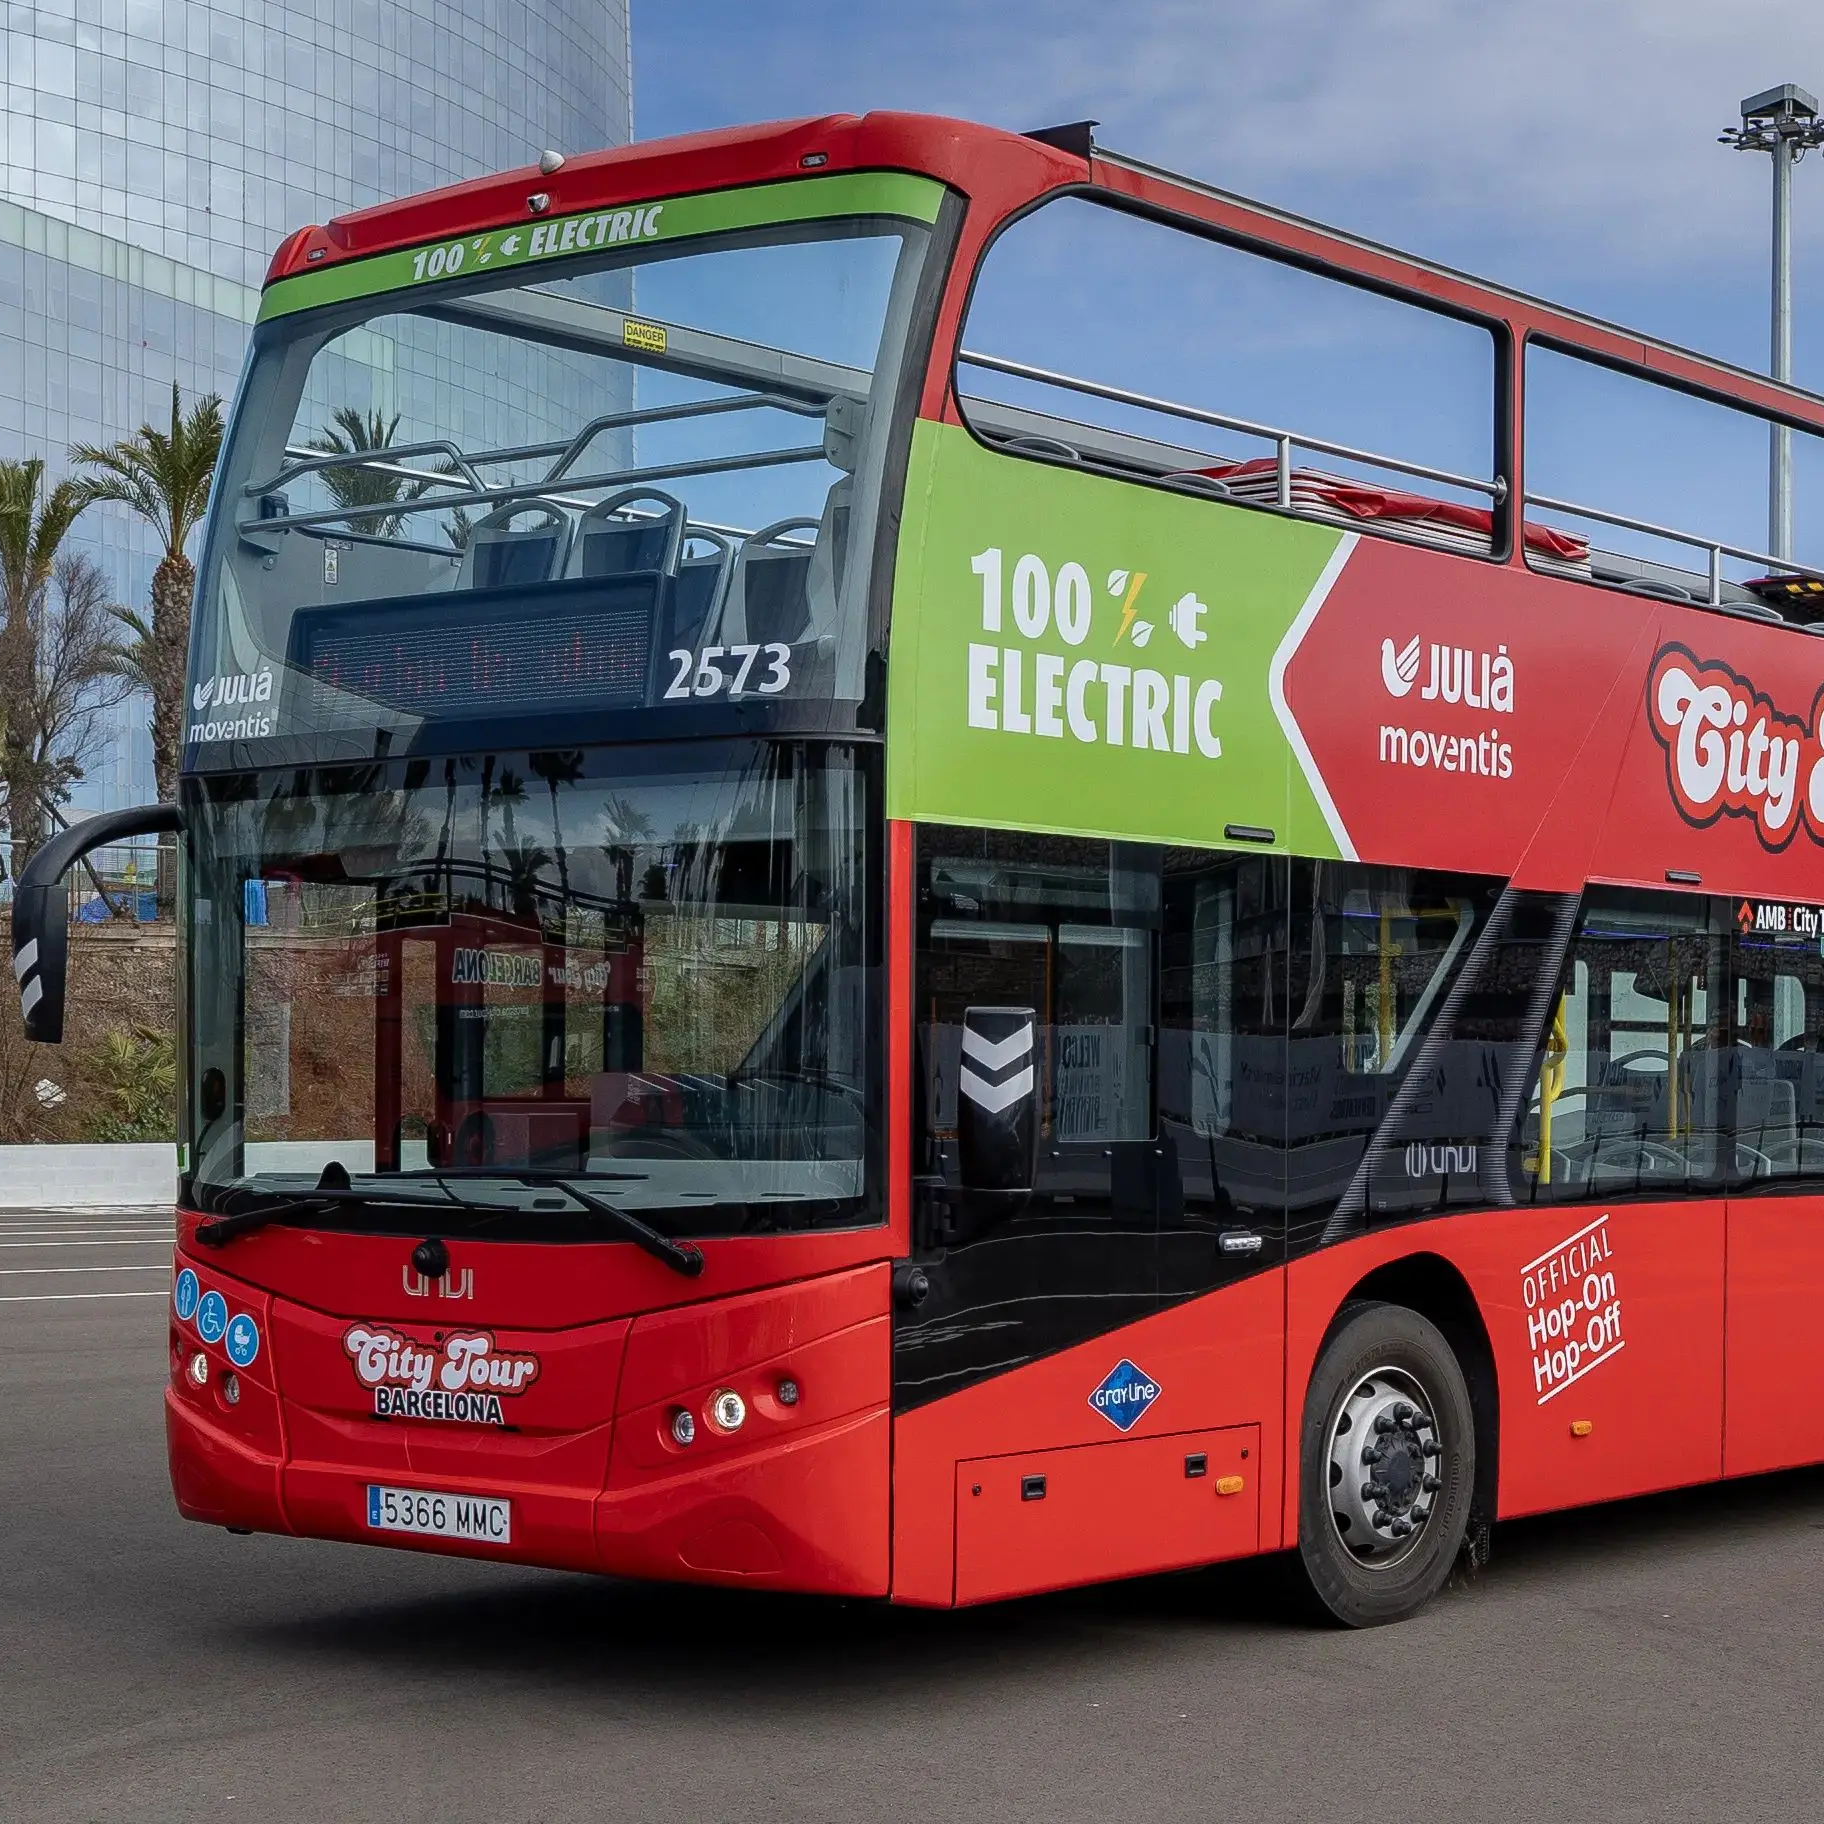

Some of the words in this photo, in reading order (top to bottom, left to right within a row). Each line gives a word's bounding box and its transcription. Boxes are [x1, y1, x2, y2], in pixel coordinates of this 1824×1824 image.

[413, 243, 464, 280] 100
[528, 206, 664, 256] ELECTRIC
[626, 325, 664, 343] DANGER
[971, 547, 1092, 645] 100
[663, 642, 791, 699] 2573
[189, 711, 270, 743] moventis
[968, 642, 1223, 759] ELECTRIC
[1379, 725, 1513, 779] moventis
[1658, 668, 1799, 829] City
[1755, 905, 1786, 931] AMB
[1793, 907, 1818, 938] City
[1523, 1228, 1613, 1308] OFFICIAL
[1528, 1272, 1615, 1351] Hop-On
[347, 1330, 434, 1392] City
[441, 1338, 534, 1389] Tour
[1533, 1300, 1621, 1393] Hop-Off
[376, 1386, 504, 1425] BARCELONA
[384, 1492, 446, 1529] 5366
[456, 1501, 503, 1536] MMC
